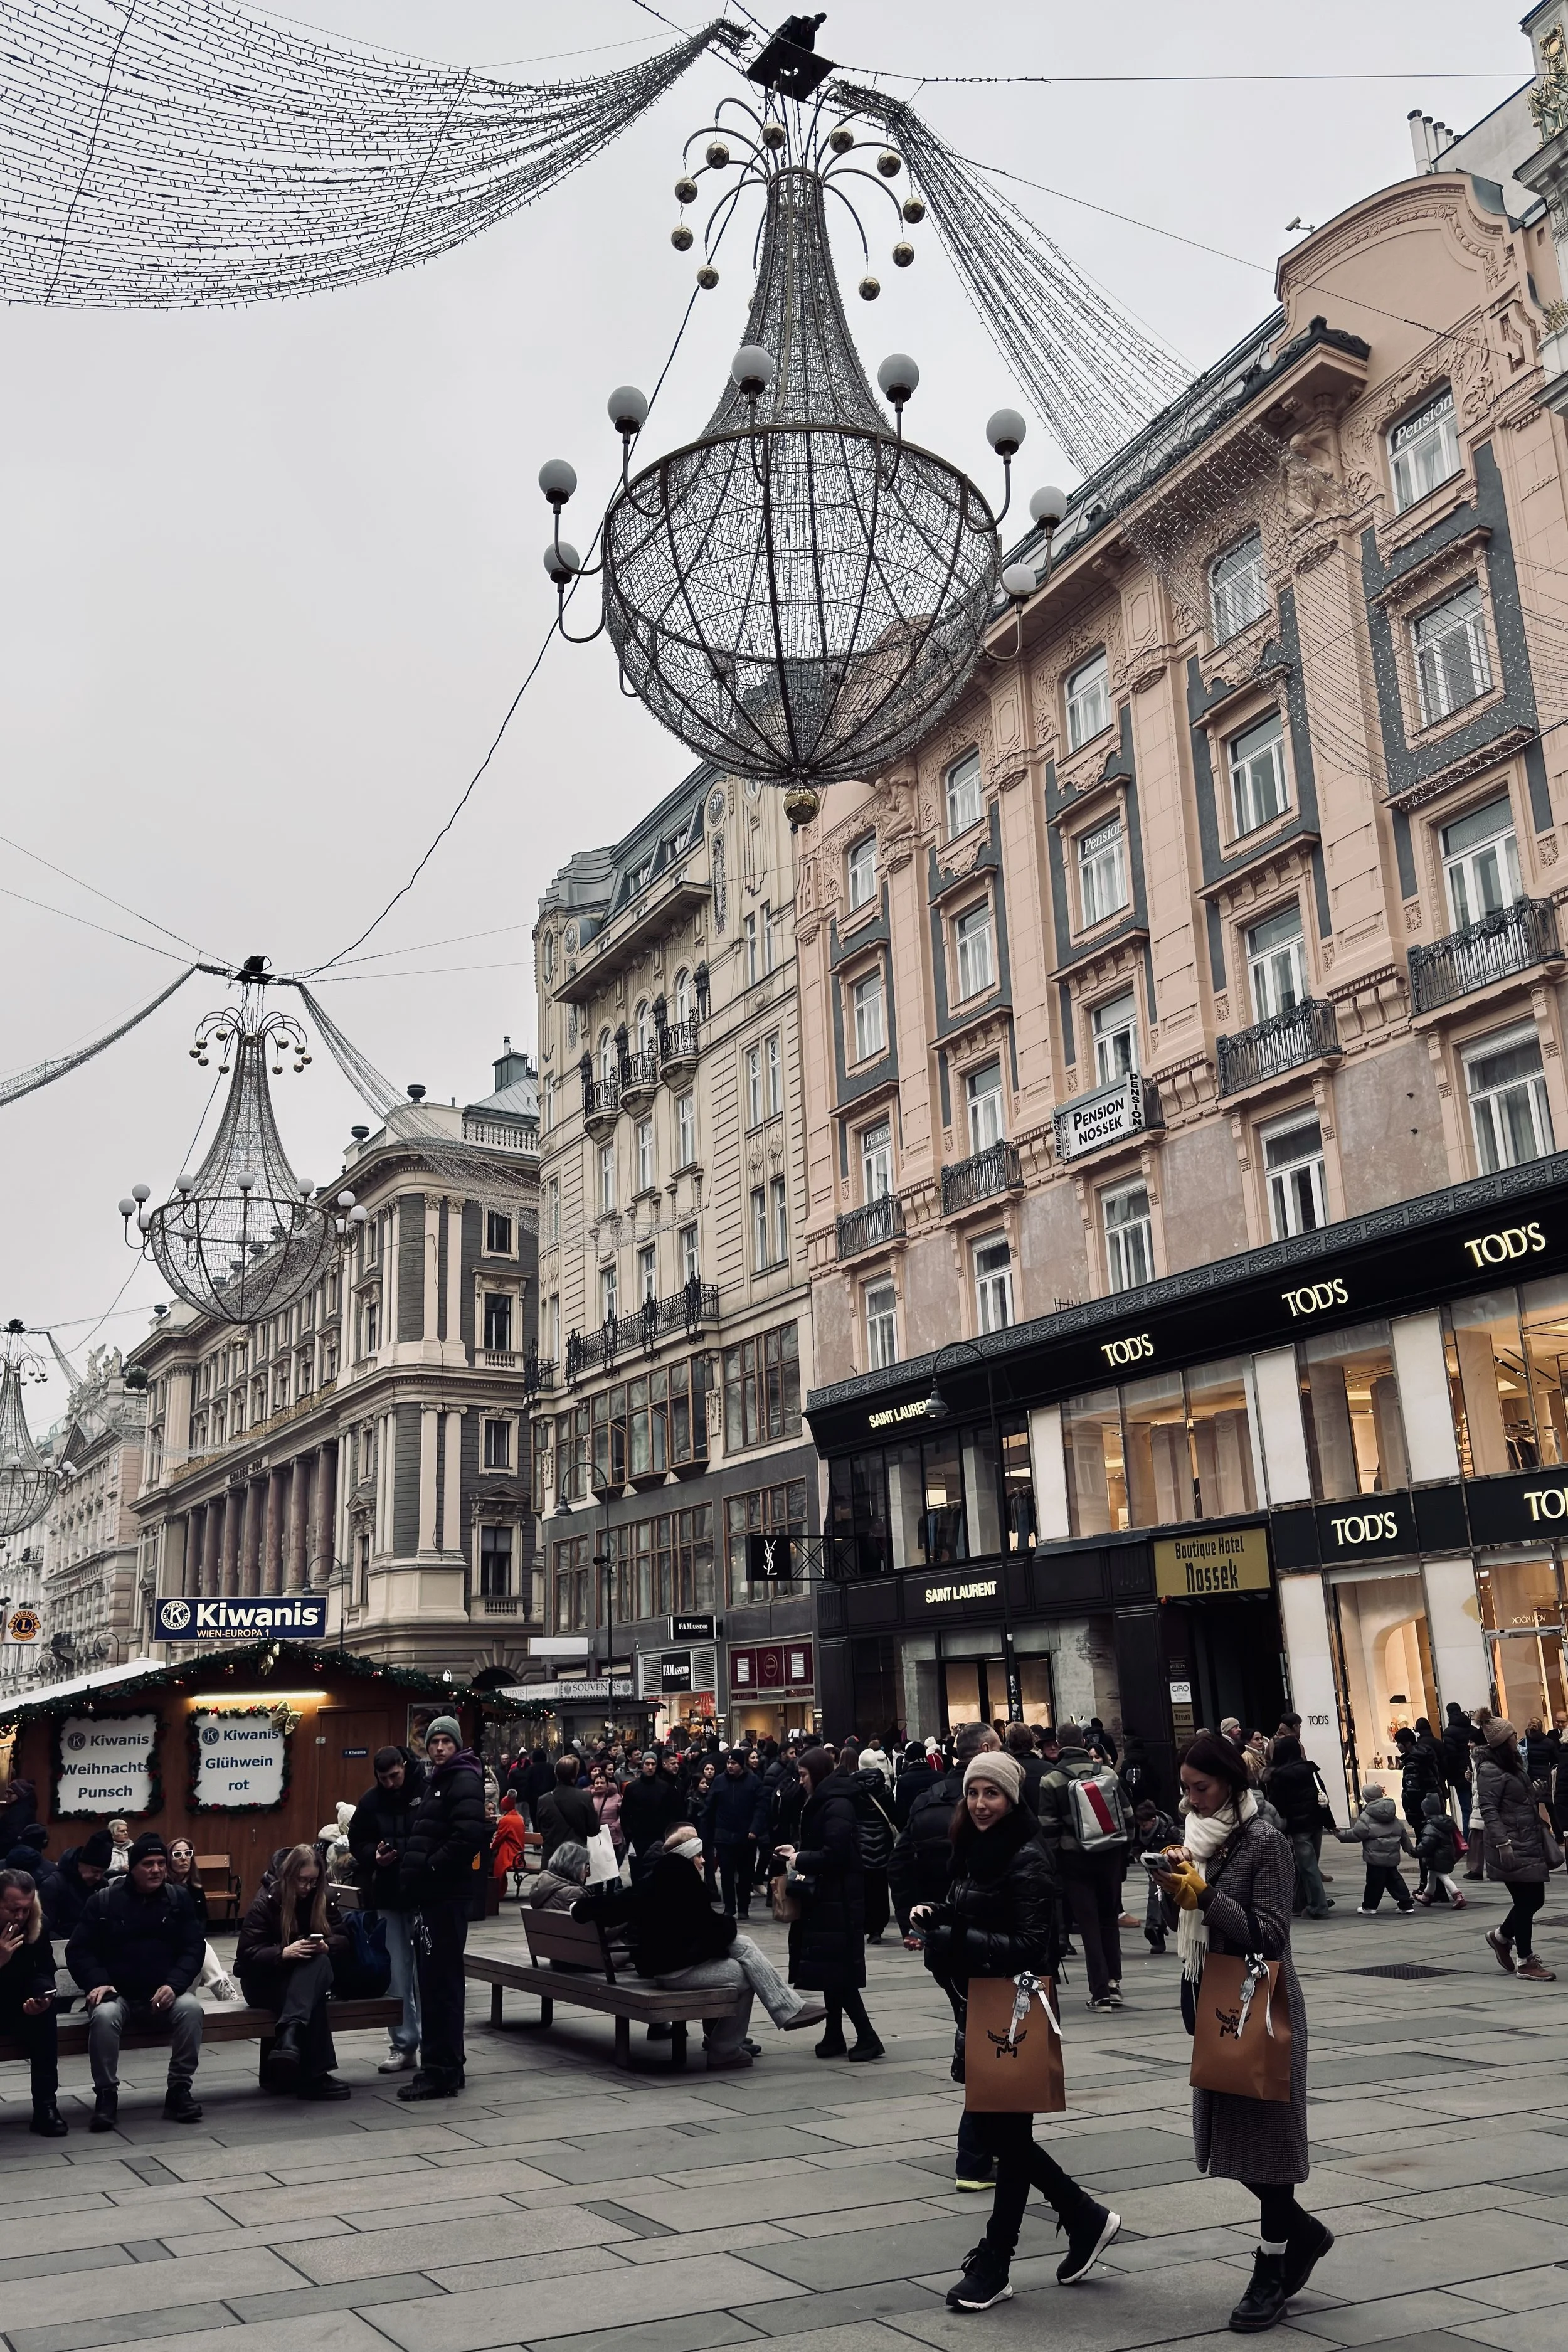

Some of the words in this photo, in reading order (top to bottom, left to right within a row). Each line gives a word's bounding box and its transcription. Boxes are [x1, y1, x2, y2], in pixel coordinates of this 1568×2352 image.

[1396, 393, 1454, 448] Pension
[1130, 1073, 1142, 1126] PENSION
[1073, 1097, 1124, 1131] PENSION
[1052, 1118, 1062, 1158] NOSSEK
[1079, 1115, 1123, 1145] NOSSEK
[1464, 1222, 1546, 1267] TOD'S
[1281, 1278, 1348, 1316] TOD'S
[1101, 1333, 1154, 1366] TOD'S
[869, 1409, 894, 1428] SAINT
[893, 1399, 931, 1421] LAUREN
[1331, 1511, 1397, 1545] TOD'S
[1175, 1540, 1216, 1560] Boutique
[1219, 1535, 1245, 1555] Hotel
[925, 1587, 952, 1603] SAINT
[953, 1581, 997, 1600] LAURENT
[196, 1601, 319, 1628] Kiwanis
[197, 1629, 263, 1638] WIEN-EUROPA
[265, 1629, 270, 1637] 1
[90, 1733, 149, 1747] Kiwanis
[223, 1728, 279, 1741] Kiwanis
[63, 1761, 149, 1776] Weihnachts
[205, 1755, 273, 1769] Glühwein
[78, 1784, 132, 1799] Punsch
[228, 1779, 250, 1791] rot
